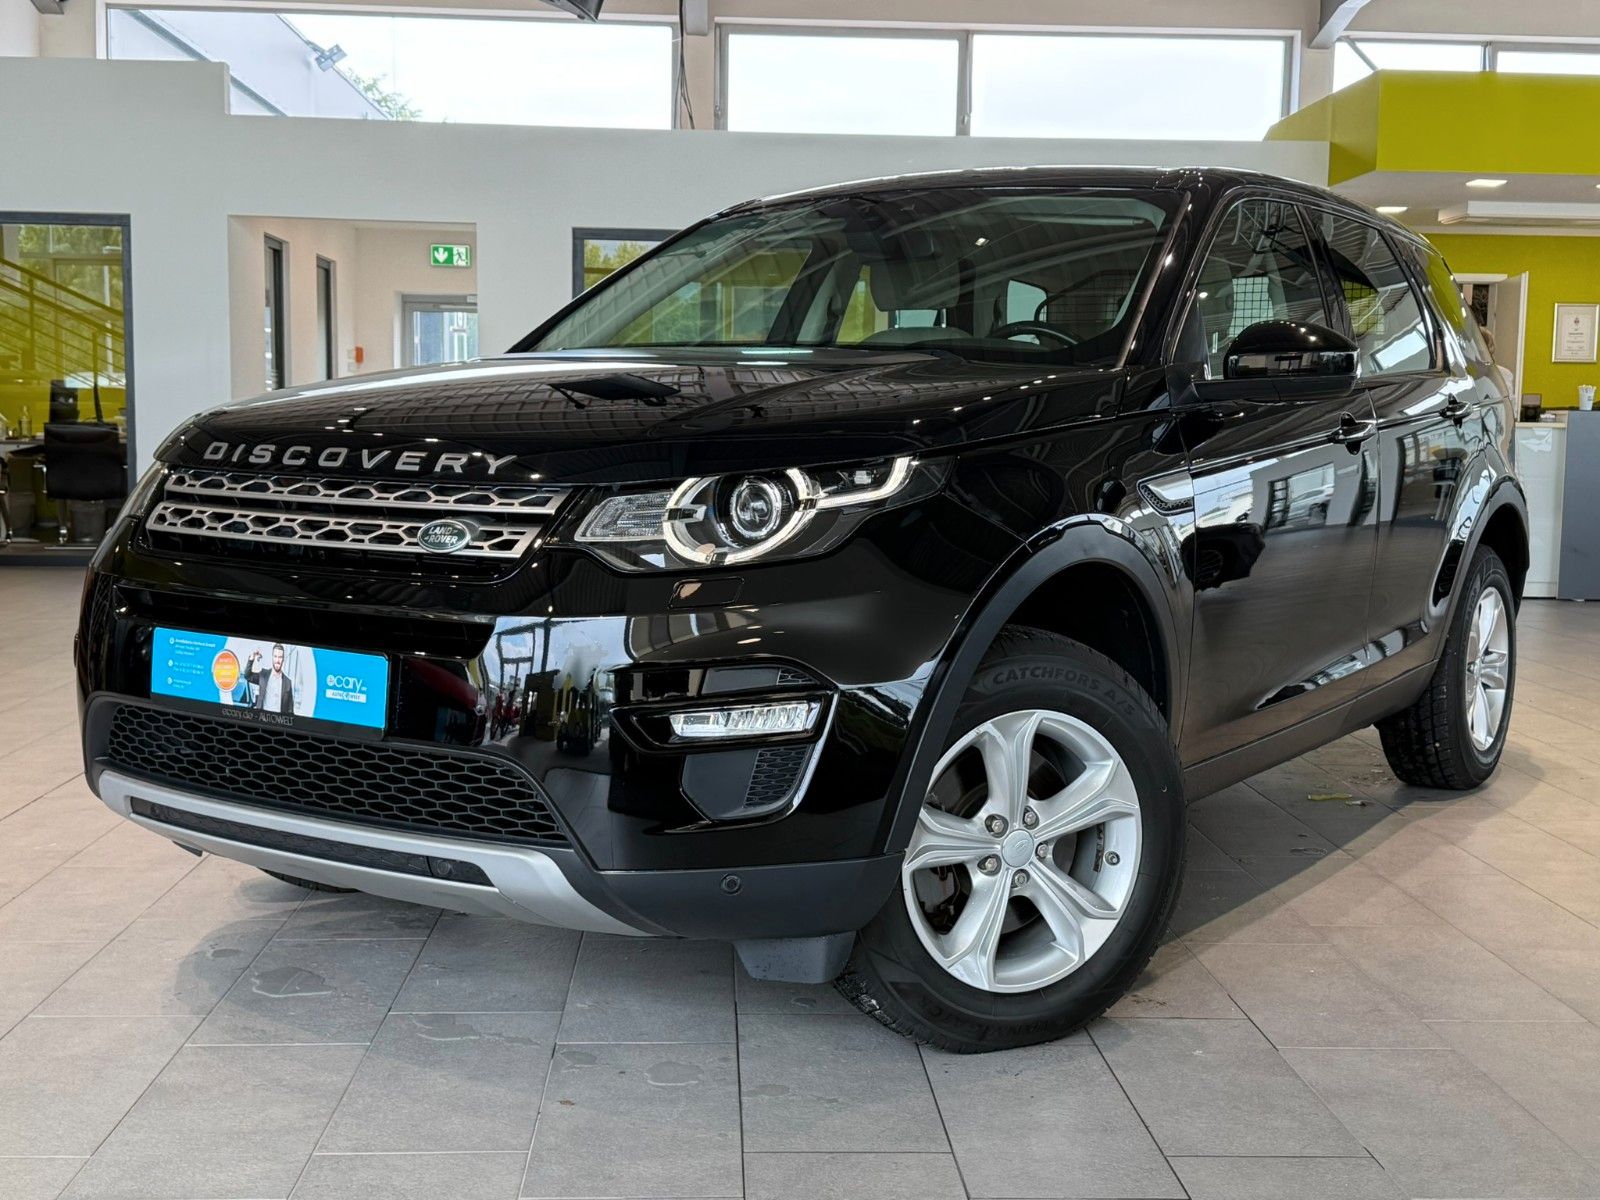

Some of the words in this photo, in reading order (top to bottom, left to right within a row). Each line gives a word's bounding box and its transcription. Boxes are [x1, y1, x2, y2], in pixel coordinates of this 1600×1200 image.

[203, 441, 517, 475] DISCOVERY
[428, 526, 453, 535] LAND
[427, 535, 459, 544] ROVER
[992, 665, 1101, 690] CATCHFORS
